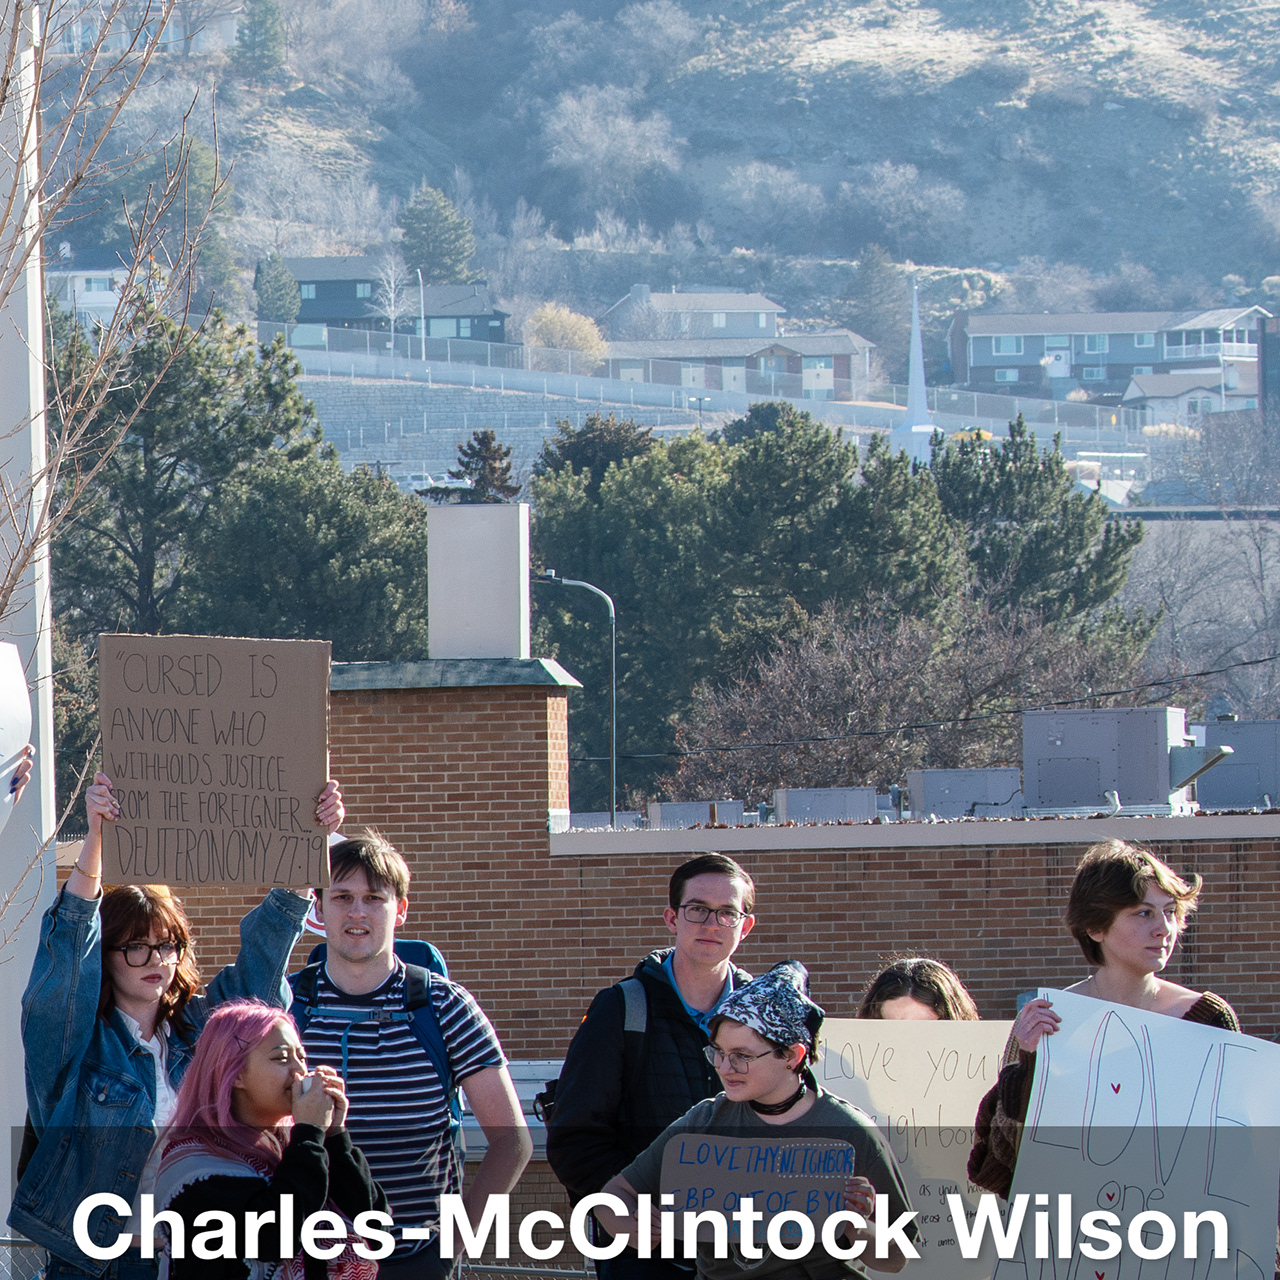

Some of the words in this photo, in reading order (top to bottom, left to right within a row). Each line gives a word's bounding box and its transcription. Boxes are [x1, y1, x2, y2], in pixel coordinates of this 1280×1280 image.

[249, 654, 278, 698] IS
[110, 707, 201, 745] ANYONE
[210, 710, 267, 746] WHO
[110, 751, 213, 786] WITHHOLDS
[219, 753, 288, 792] JUSTICE
[160, 790, 189, 822] THE
[115, 825, 273, 884] DEUTERONOMY
[273, 835, 323, 885] 27:19
[1030, 993, 1257, 1207] LOVE
[679, 1141, 740, 1170] LOVE
[742, 1145, 780, 1173] THY
[780, 1147, 854, 1174] NEIGHBOR
[666, 1187, 715, 1212] CBP
[766, 1190, 798, 1214] OF
